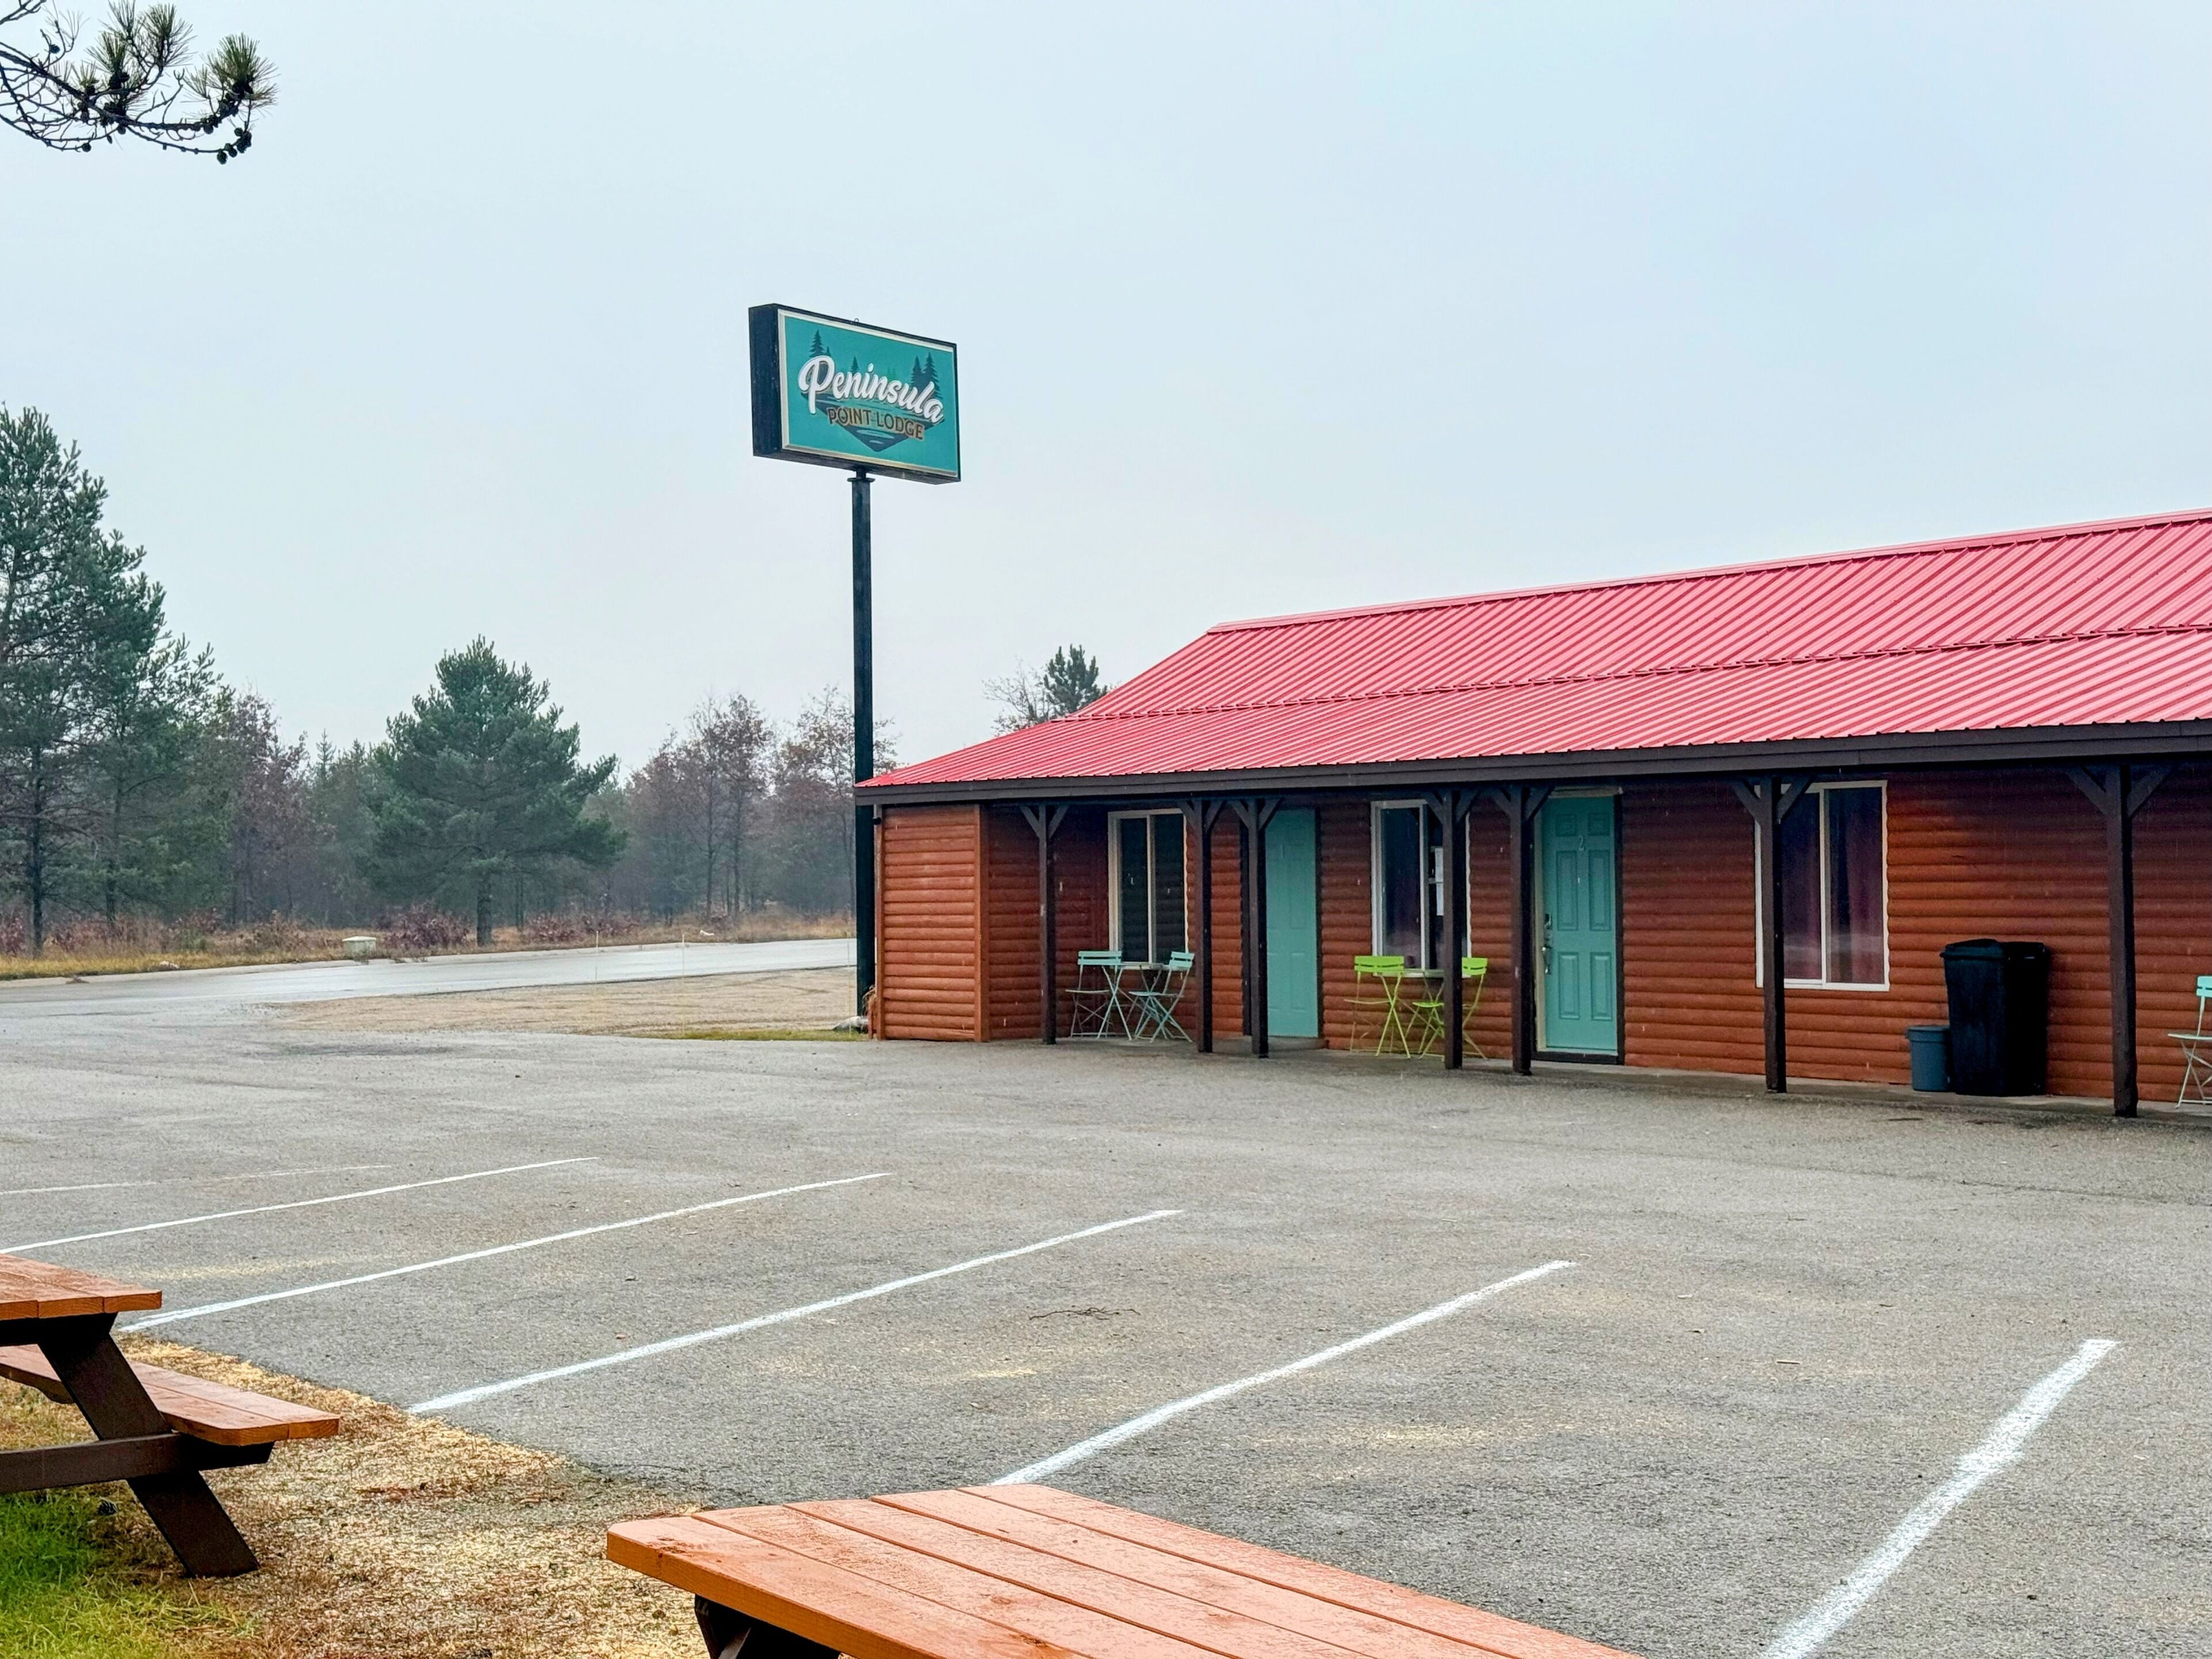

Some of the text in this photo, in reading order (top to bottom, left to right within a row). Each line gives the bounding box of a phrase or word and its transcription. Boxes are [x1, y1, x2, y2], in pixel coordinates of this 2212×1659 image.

[798, 355, 944, 424] Peninsula
[828, 407, 924, 440] POINT LODGE
